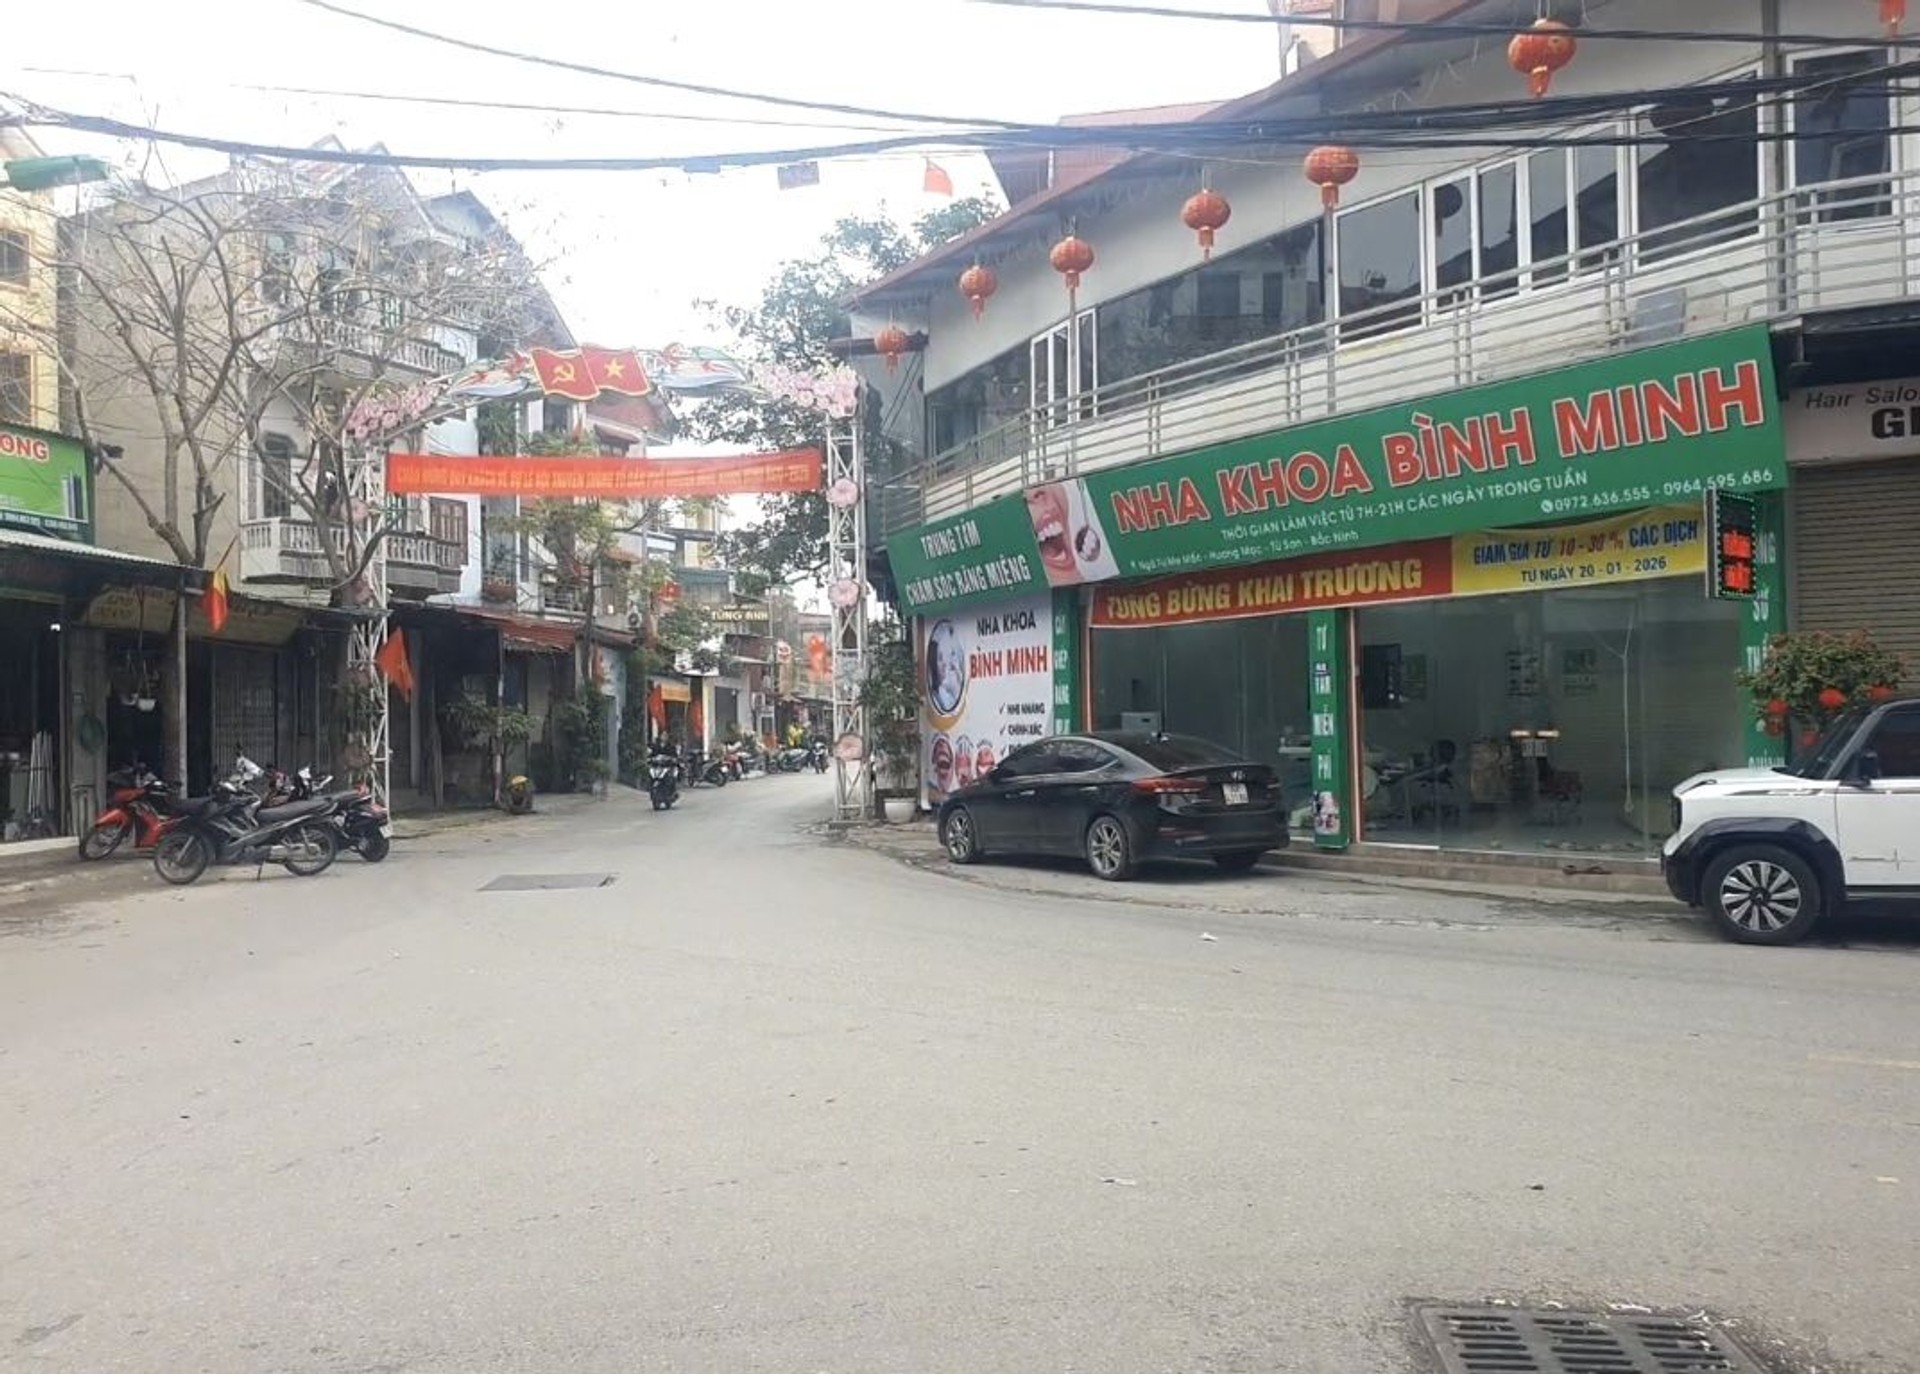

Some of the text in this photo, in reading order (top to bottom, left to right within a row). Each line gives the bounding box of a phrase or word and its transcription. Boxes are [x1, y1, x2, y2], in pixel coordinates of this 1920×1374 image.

[1806, 386, 1920, 409] Hair Salo
[1111, 360, 1764, 534] NHA KHOA BÌNH MINH
[1250, 521, 1279, 536] GIAN
[1283, 515, 1307, 531] LÀM
[1310, 510, 1338, 526] VIỆC
[1407, 493, 1438, 511] CÁC
[1442, 485, 1485, 506] NGÀY
[1488, 478, 1541, 498] TRONG
[1555, 485, 1650, 512] 0972.636.555
[1663, 469, 1773, 496] 0964.595.686
[921, 528, 957, 560] TRUNG
[1579, 564, 1596, 578] 20
[1606, 560, 1622, 575] 01
[1635, 556, 1667, 574] 2026
[1238, 573, 1296, 607] KHAI
[977, 611, 1036, 637] NHA KHOA
[970, 646, 1048, 679] BÌNH MINH
